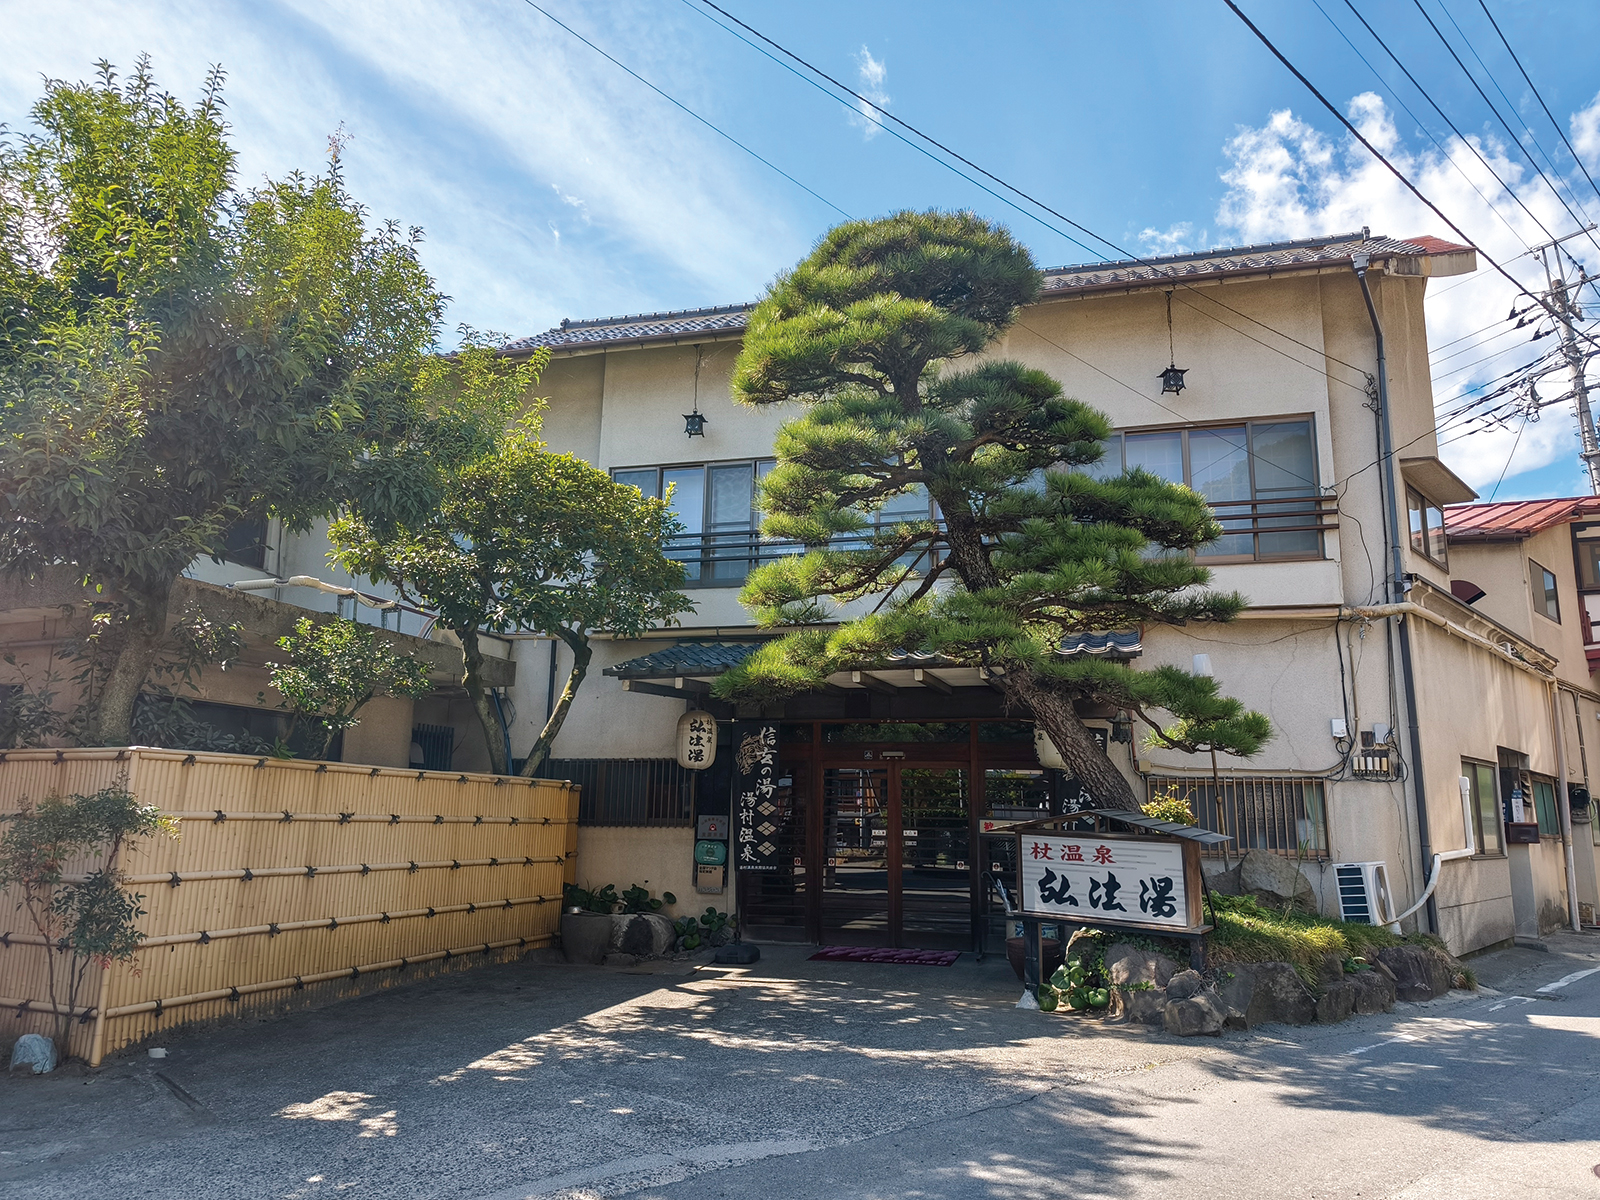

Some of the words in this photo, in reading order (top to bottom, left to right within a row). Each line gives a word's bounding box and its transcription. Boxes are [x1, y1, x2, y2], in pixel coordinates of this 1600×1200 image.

[755, 726, 777, 799] 信玄の湯
[739, 791, 758, 862] 湯村温泉
[1030, 842, 1117, 865] 杖温泉
[1038, 866, 1177, 918] 弘法湯
